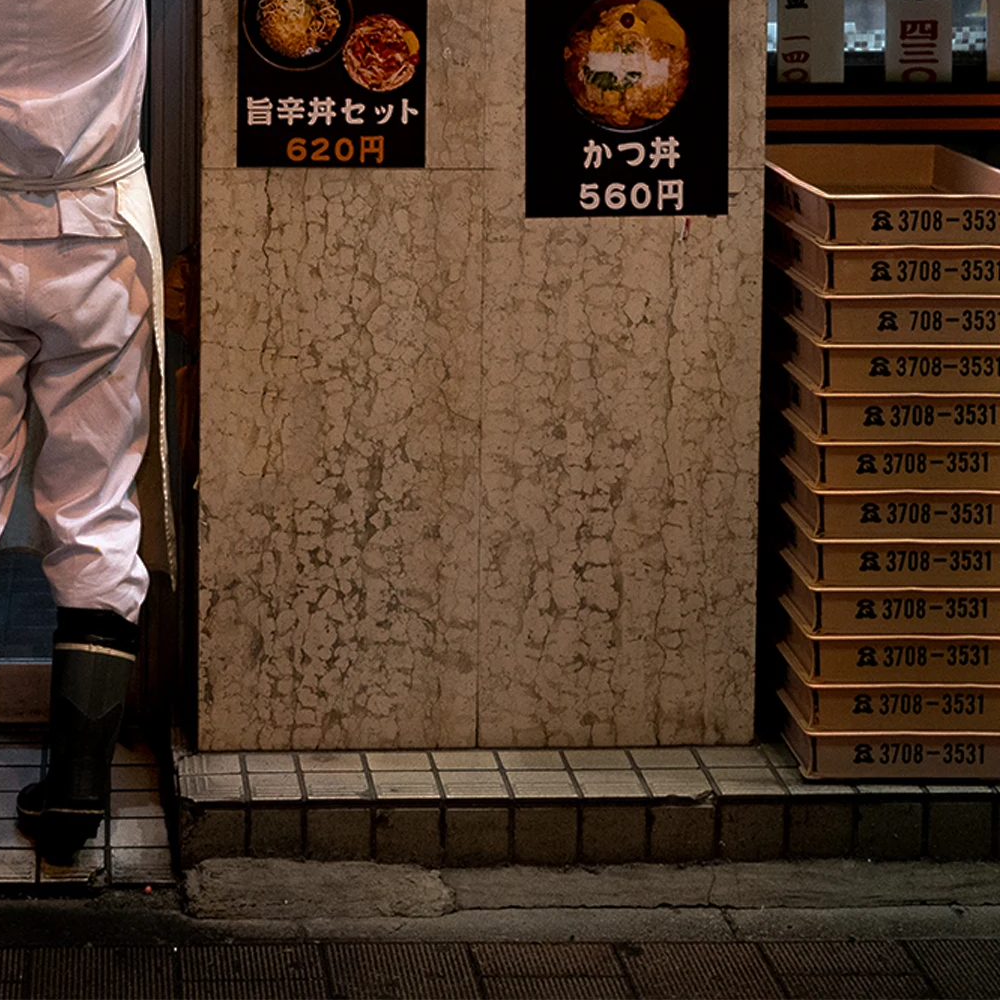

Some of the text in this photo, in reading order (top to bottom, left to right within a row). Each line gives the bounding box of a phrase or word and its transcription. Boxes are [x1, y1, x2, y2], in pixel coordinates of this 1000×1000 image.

[246, 96, 419, 126] 旨辛丼セット
[286, 135, 385, 164] 620円
[583, 137, 680, 168] かつ丼
[579, 179, 684, 210] 560円
[890, 404, 996, 427] 3708-3531
[883, 452, 988, 474] 3708-3531
[886, 503, 993, 525] 3708-3531
[885, 550, 992, 572] 3708-3531
[882, 598, 988, 620] 3708-3531
[883, 645, 989, 667] 3708-3531
[879, 694, 984, 715] 3708-3531
[879, 743, 984, 764] 3708-3531
